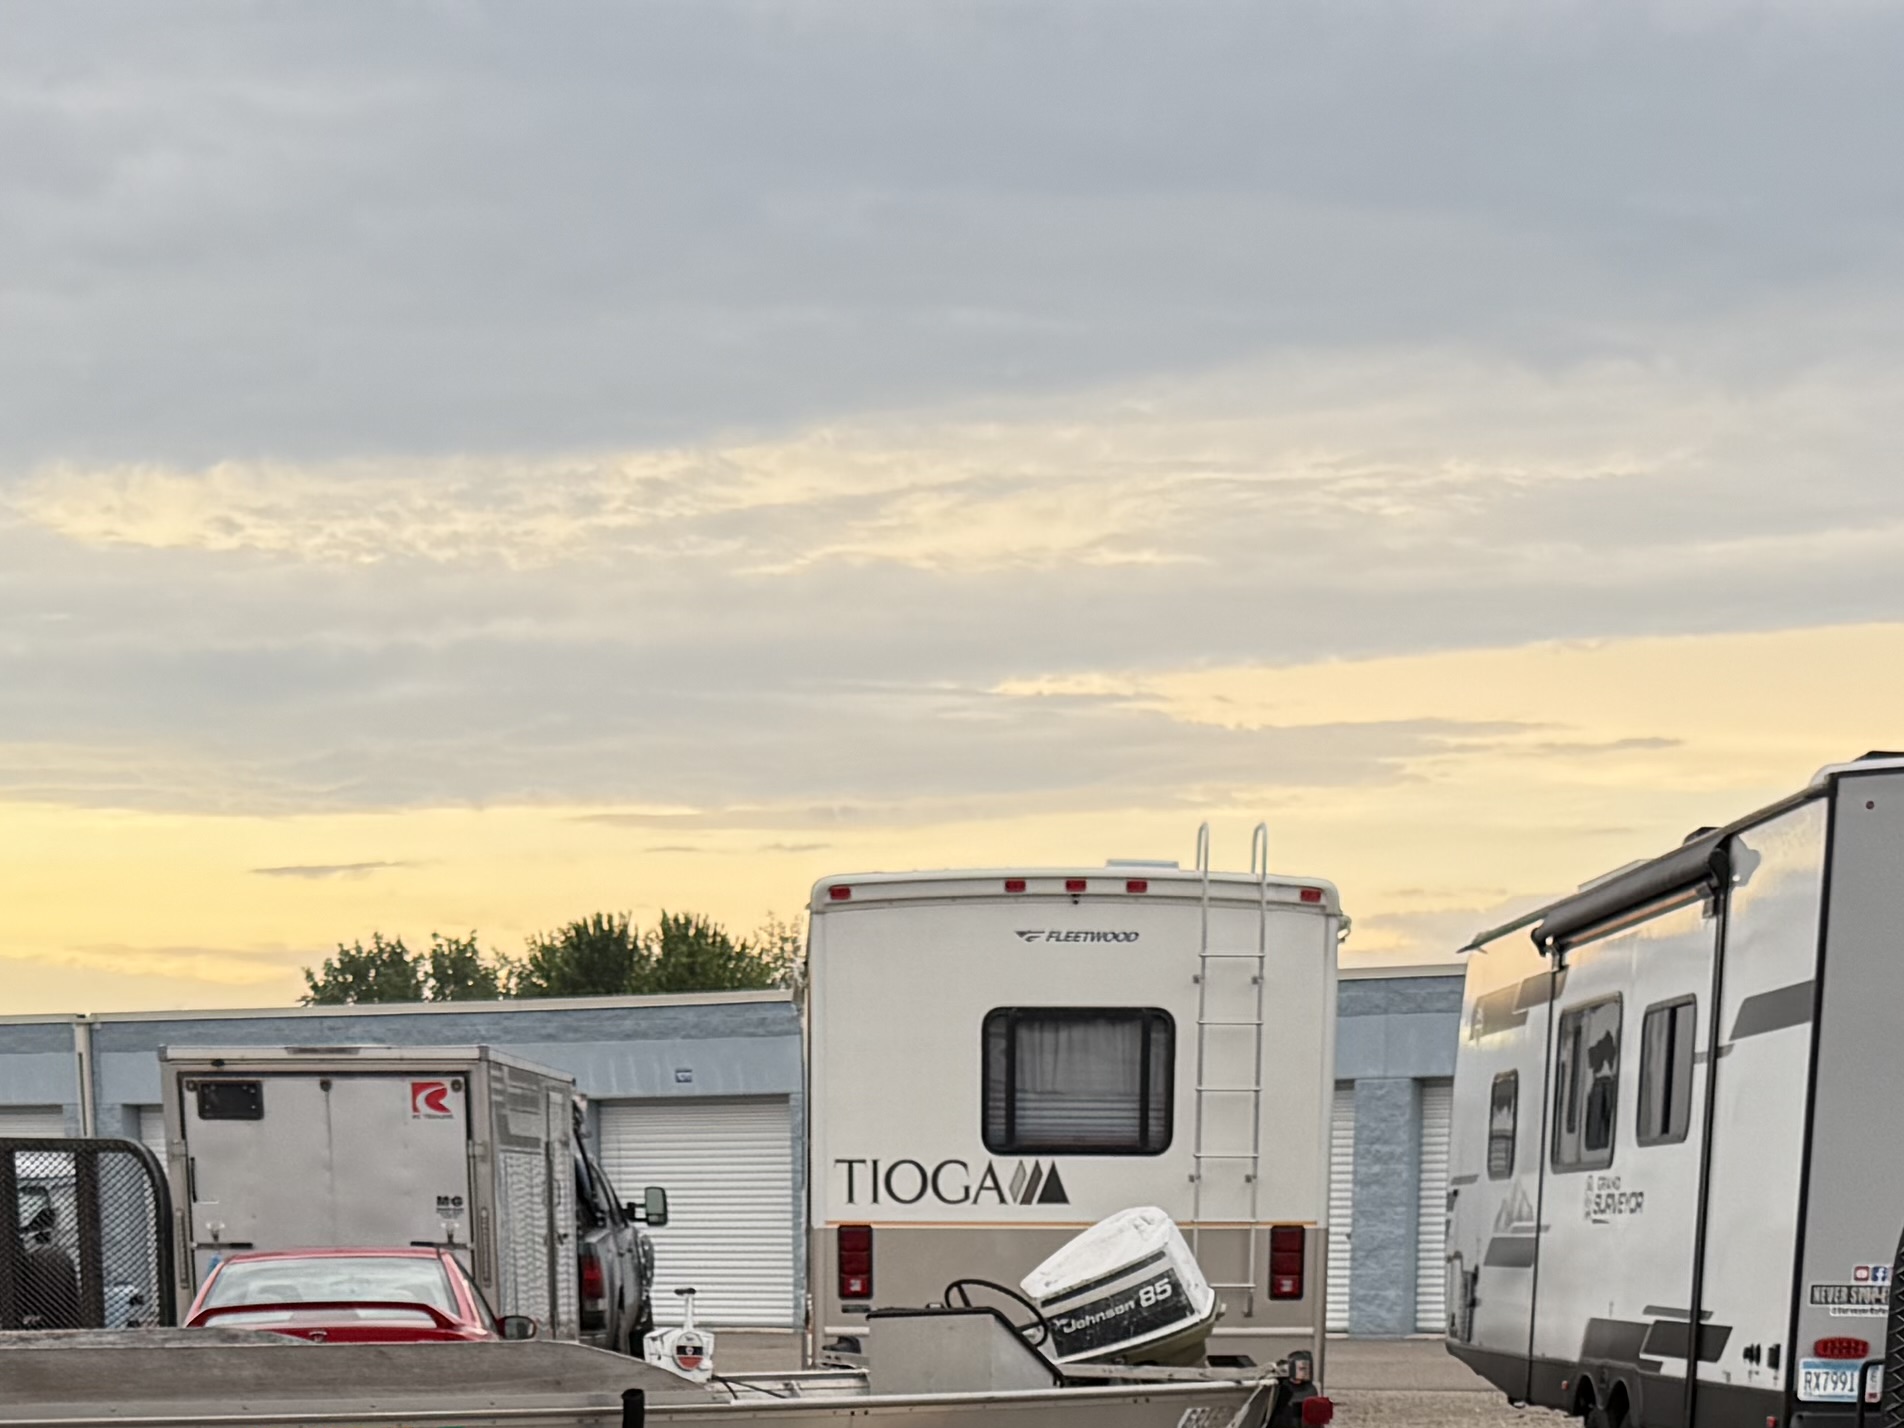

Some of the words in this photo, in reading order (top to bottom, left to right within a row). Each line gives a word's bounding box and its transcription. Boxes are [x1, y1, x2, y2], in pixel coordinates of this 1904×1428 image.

[1046, 931, 1139, 942] FLEETWOOD
[834, 1159, 1009, 1205] TIOGA
[1063, 1300, 1136, 1334] Johnson
[1139, 1278, 1172, 1308] 85
